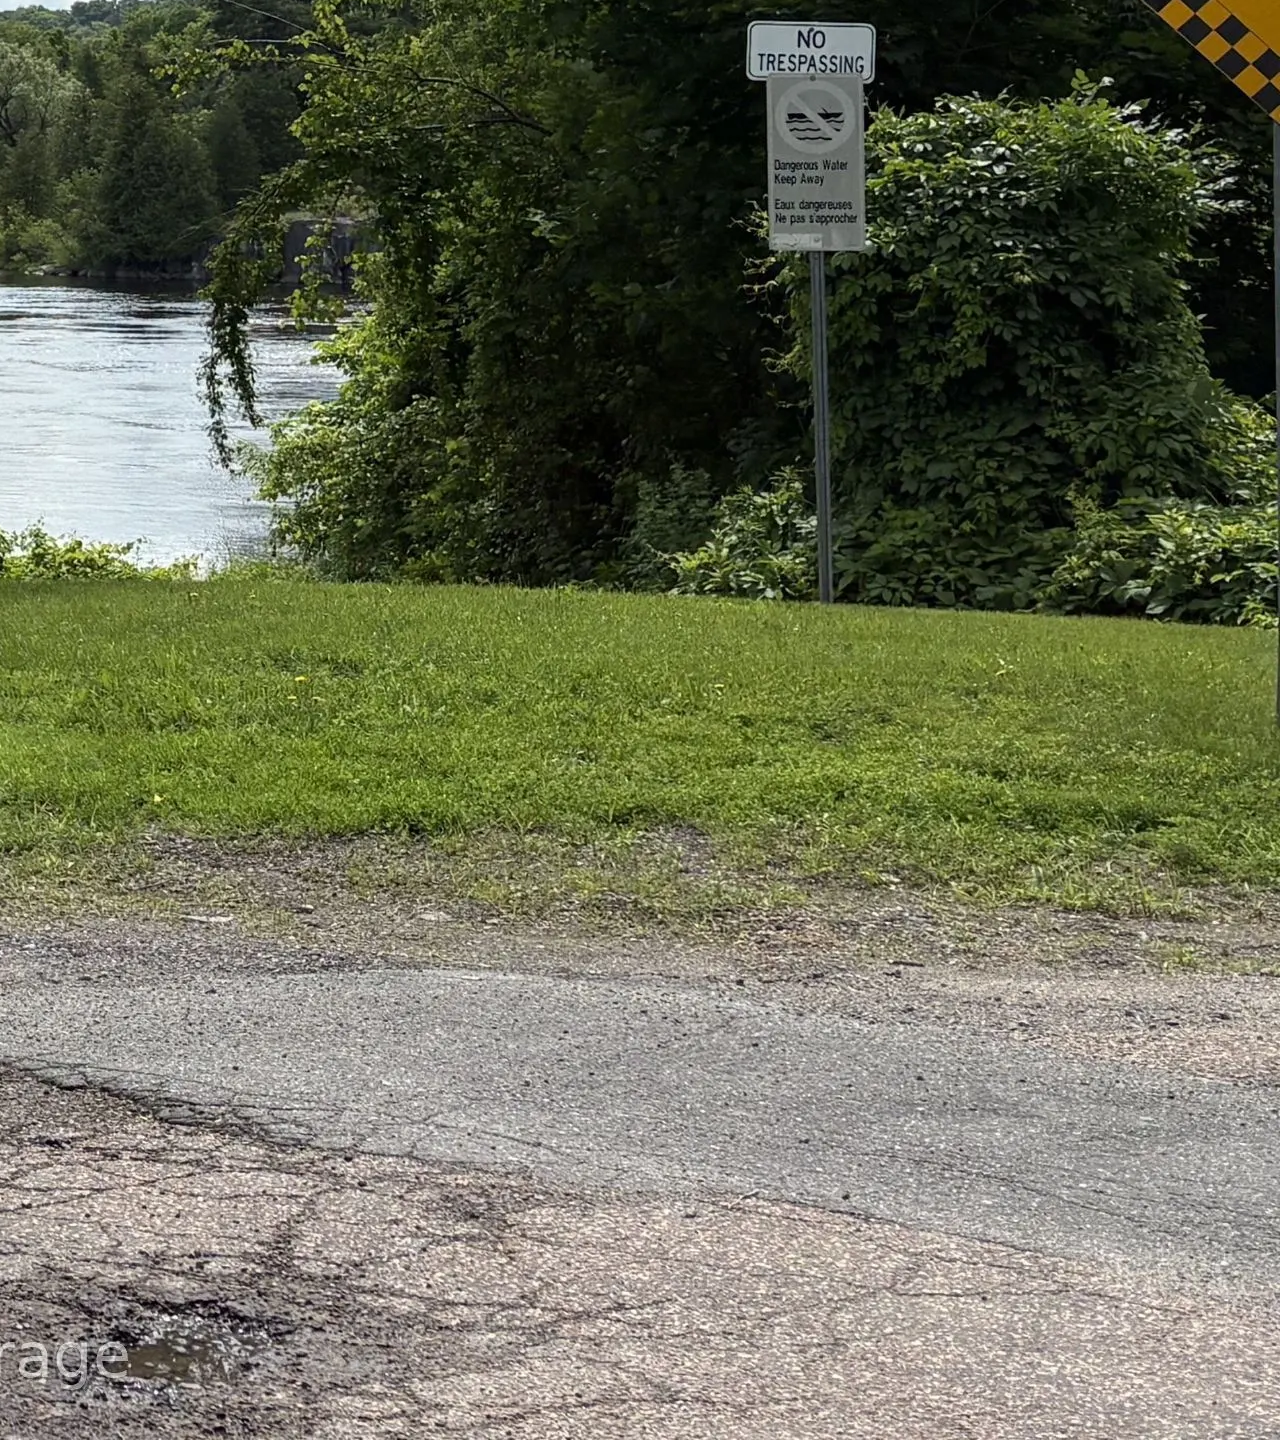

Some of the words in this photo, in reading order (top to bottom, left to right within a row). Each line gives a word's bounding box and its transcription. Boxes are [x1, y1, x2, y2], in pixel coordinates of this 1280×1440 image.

[797, 29, 826, 49] NO
[757, 53, 865, 74] TRESPASSING
[774, 159, 819, 172] Dangerous
[822, 159, 848, 171] Water
[774, 173, 797, 185] Keep
[800, 173, 824, 186] Away
[774, 199, 796, 210] Eaux
[799, 199, 853, 212] dangereuses
[775, 213, 787, 224] Ne
[790, 214, 806, 226] pas
[809, 212, 858, 226] s'approcher
